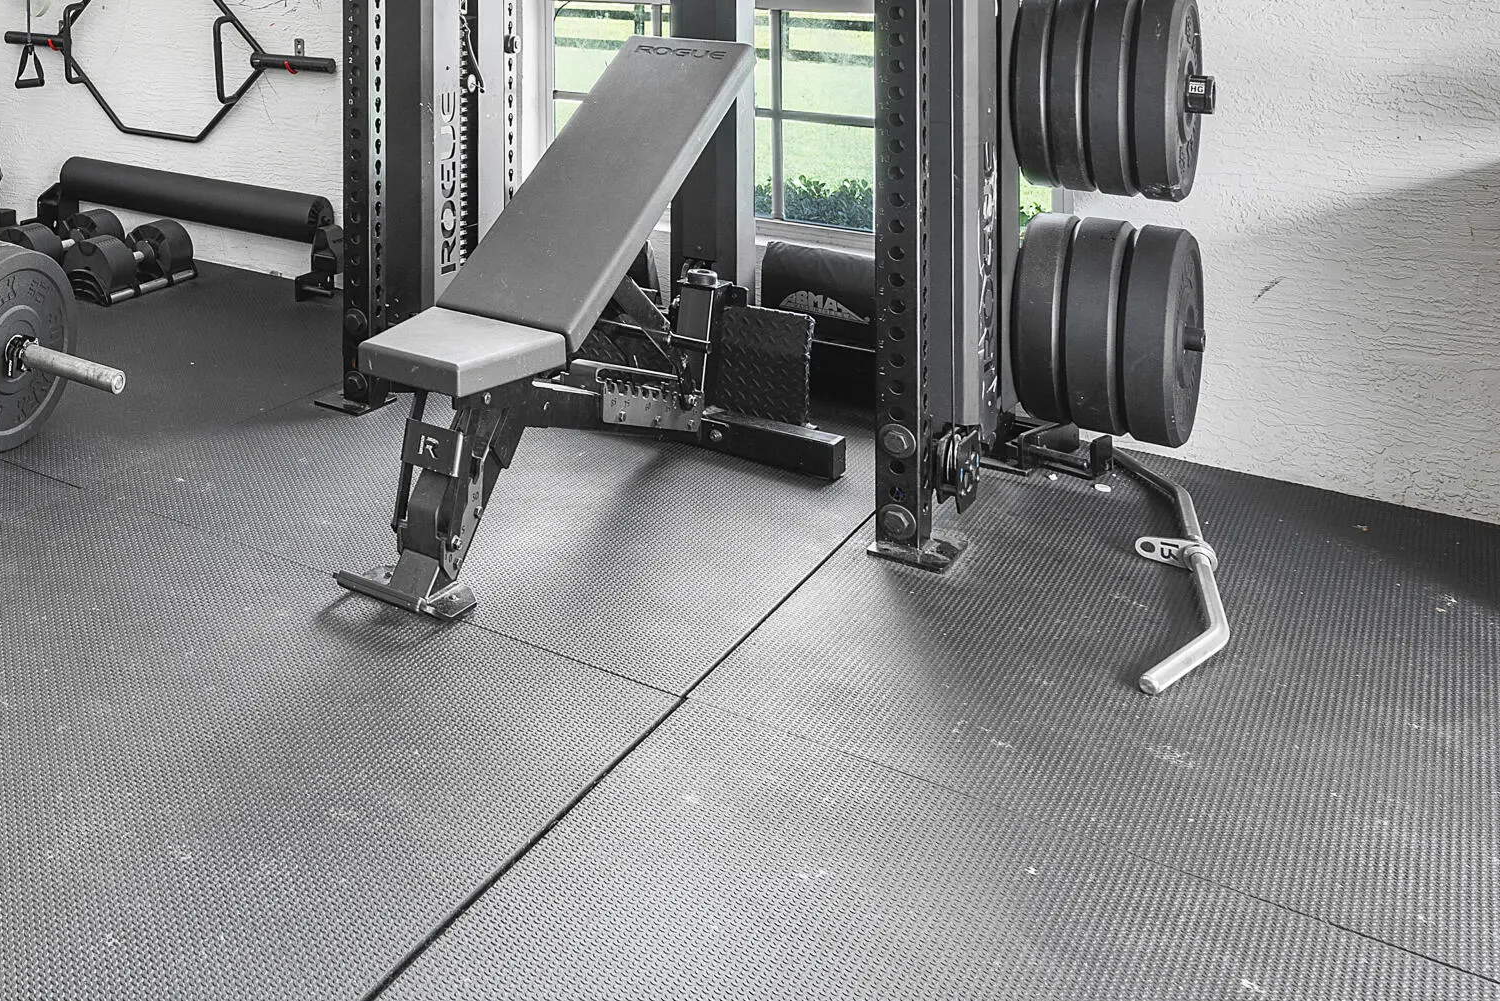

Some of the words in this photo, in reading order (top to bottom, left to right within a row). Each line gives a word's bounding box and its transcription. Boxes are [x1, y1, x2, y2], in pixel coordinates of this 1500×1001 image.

[633, 44, 727, 61] ROGUE
[1190, 85, 1204, 93] HG
[440, 91, 457, 276] ROGUE
[417, 434, 440, 460] R
